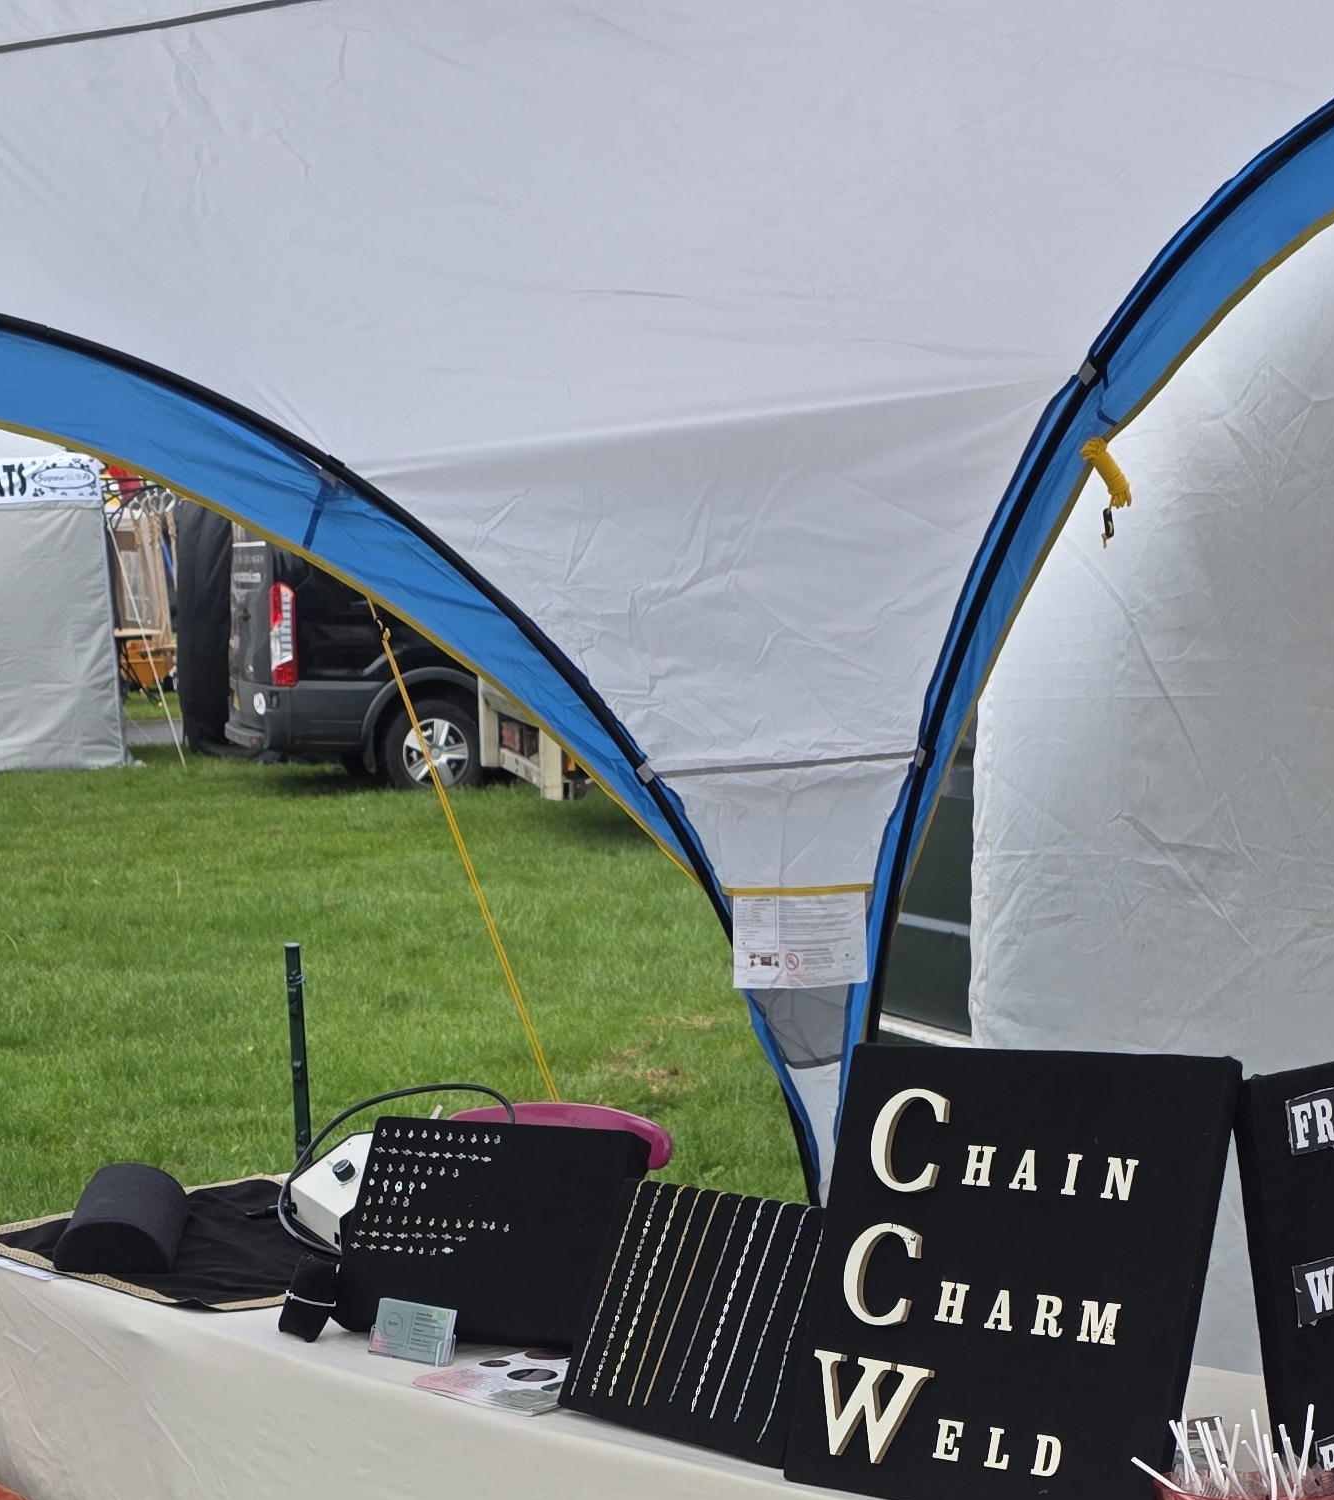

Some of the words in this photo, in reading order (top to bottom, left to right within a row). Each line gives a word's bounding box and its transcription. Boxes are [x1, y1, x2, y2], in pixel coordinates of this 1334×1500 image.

[870, 1088, 1139, 1201] CHAIN
[843, 1222, 1121, 1345] CHARM
[814, 1349, 1062, 1477] WELD
